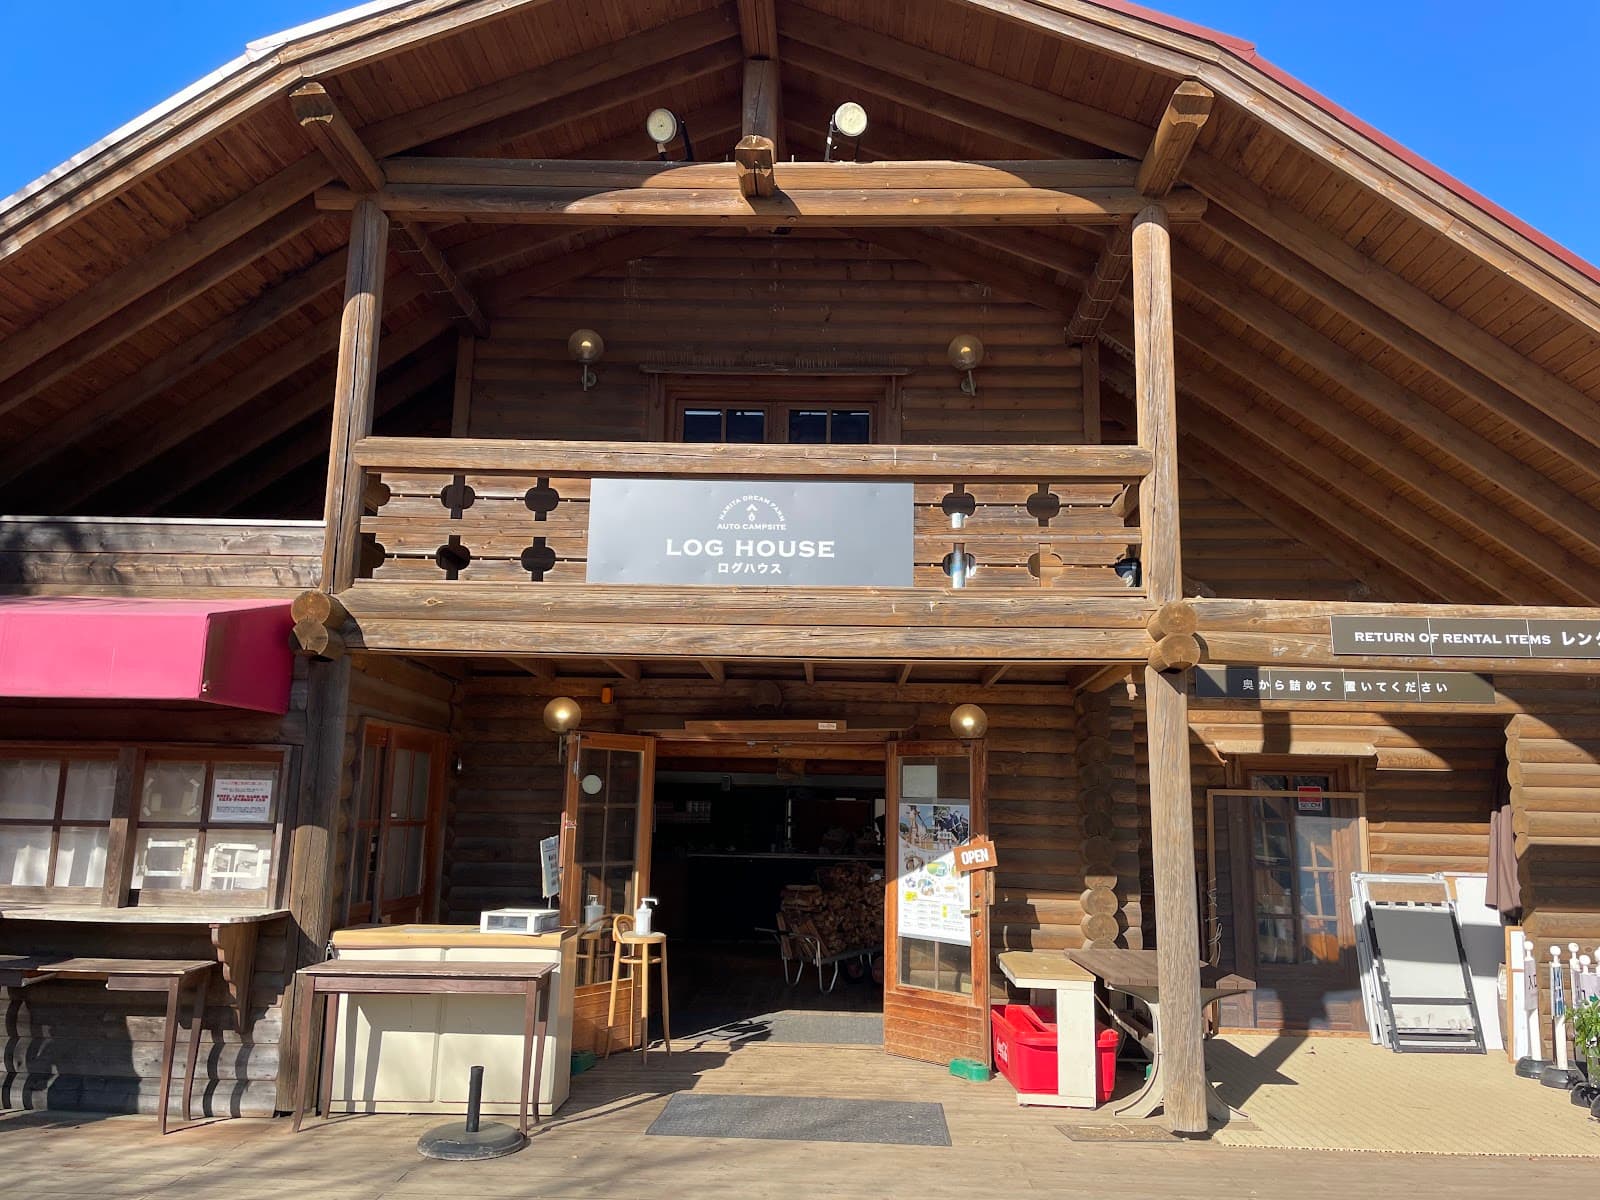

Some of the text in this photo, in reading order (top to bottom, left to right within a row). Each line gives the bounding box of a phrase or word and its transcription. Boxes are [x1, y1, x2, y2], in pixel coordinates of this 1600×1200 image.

[742, 523, 787, 531] CAMPSITE
[666, 539, 835, 558] LOG HOUSE
[718, 562, 782, 574] ログハウス
[1354, 631, 1416, 643] RETURN
[1418, 633, 1439, 643] OF
[1443, 633, 1503, 644] RENTAL
[1505, 634, 1552, 645] ITEMS
[1243, 679, 1448, 693] 奥から詰めて 置いてください
[961, 848, 989, 865] OPEN
